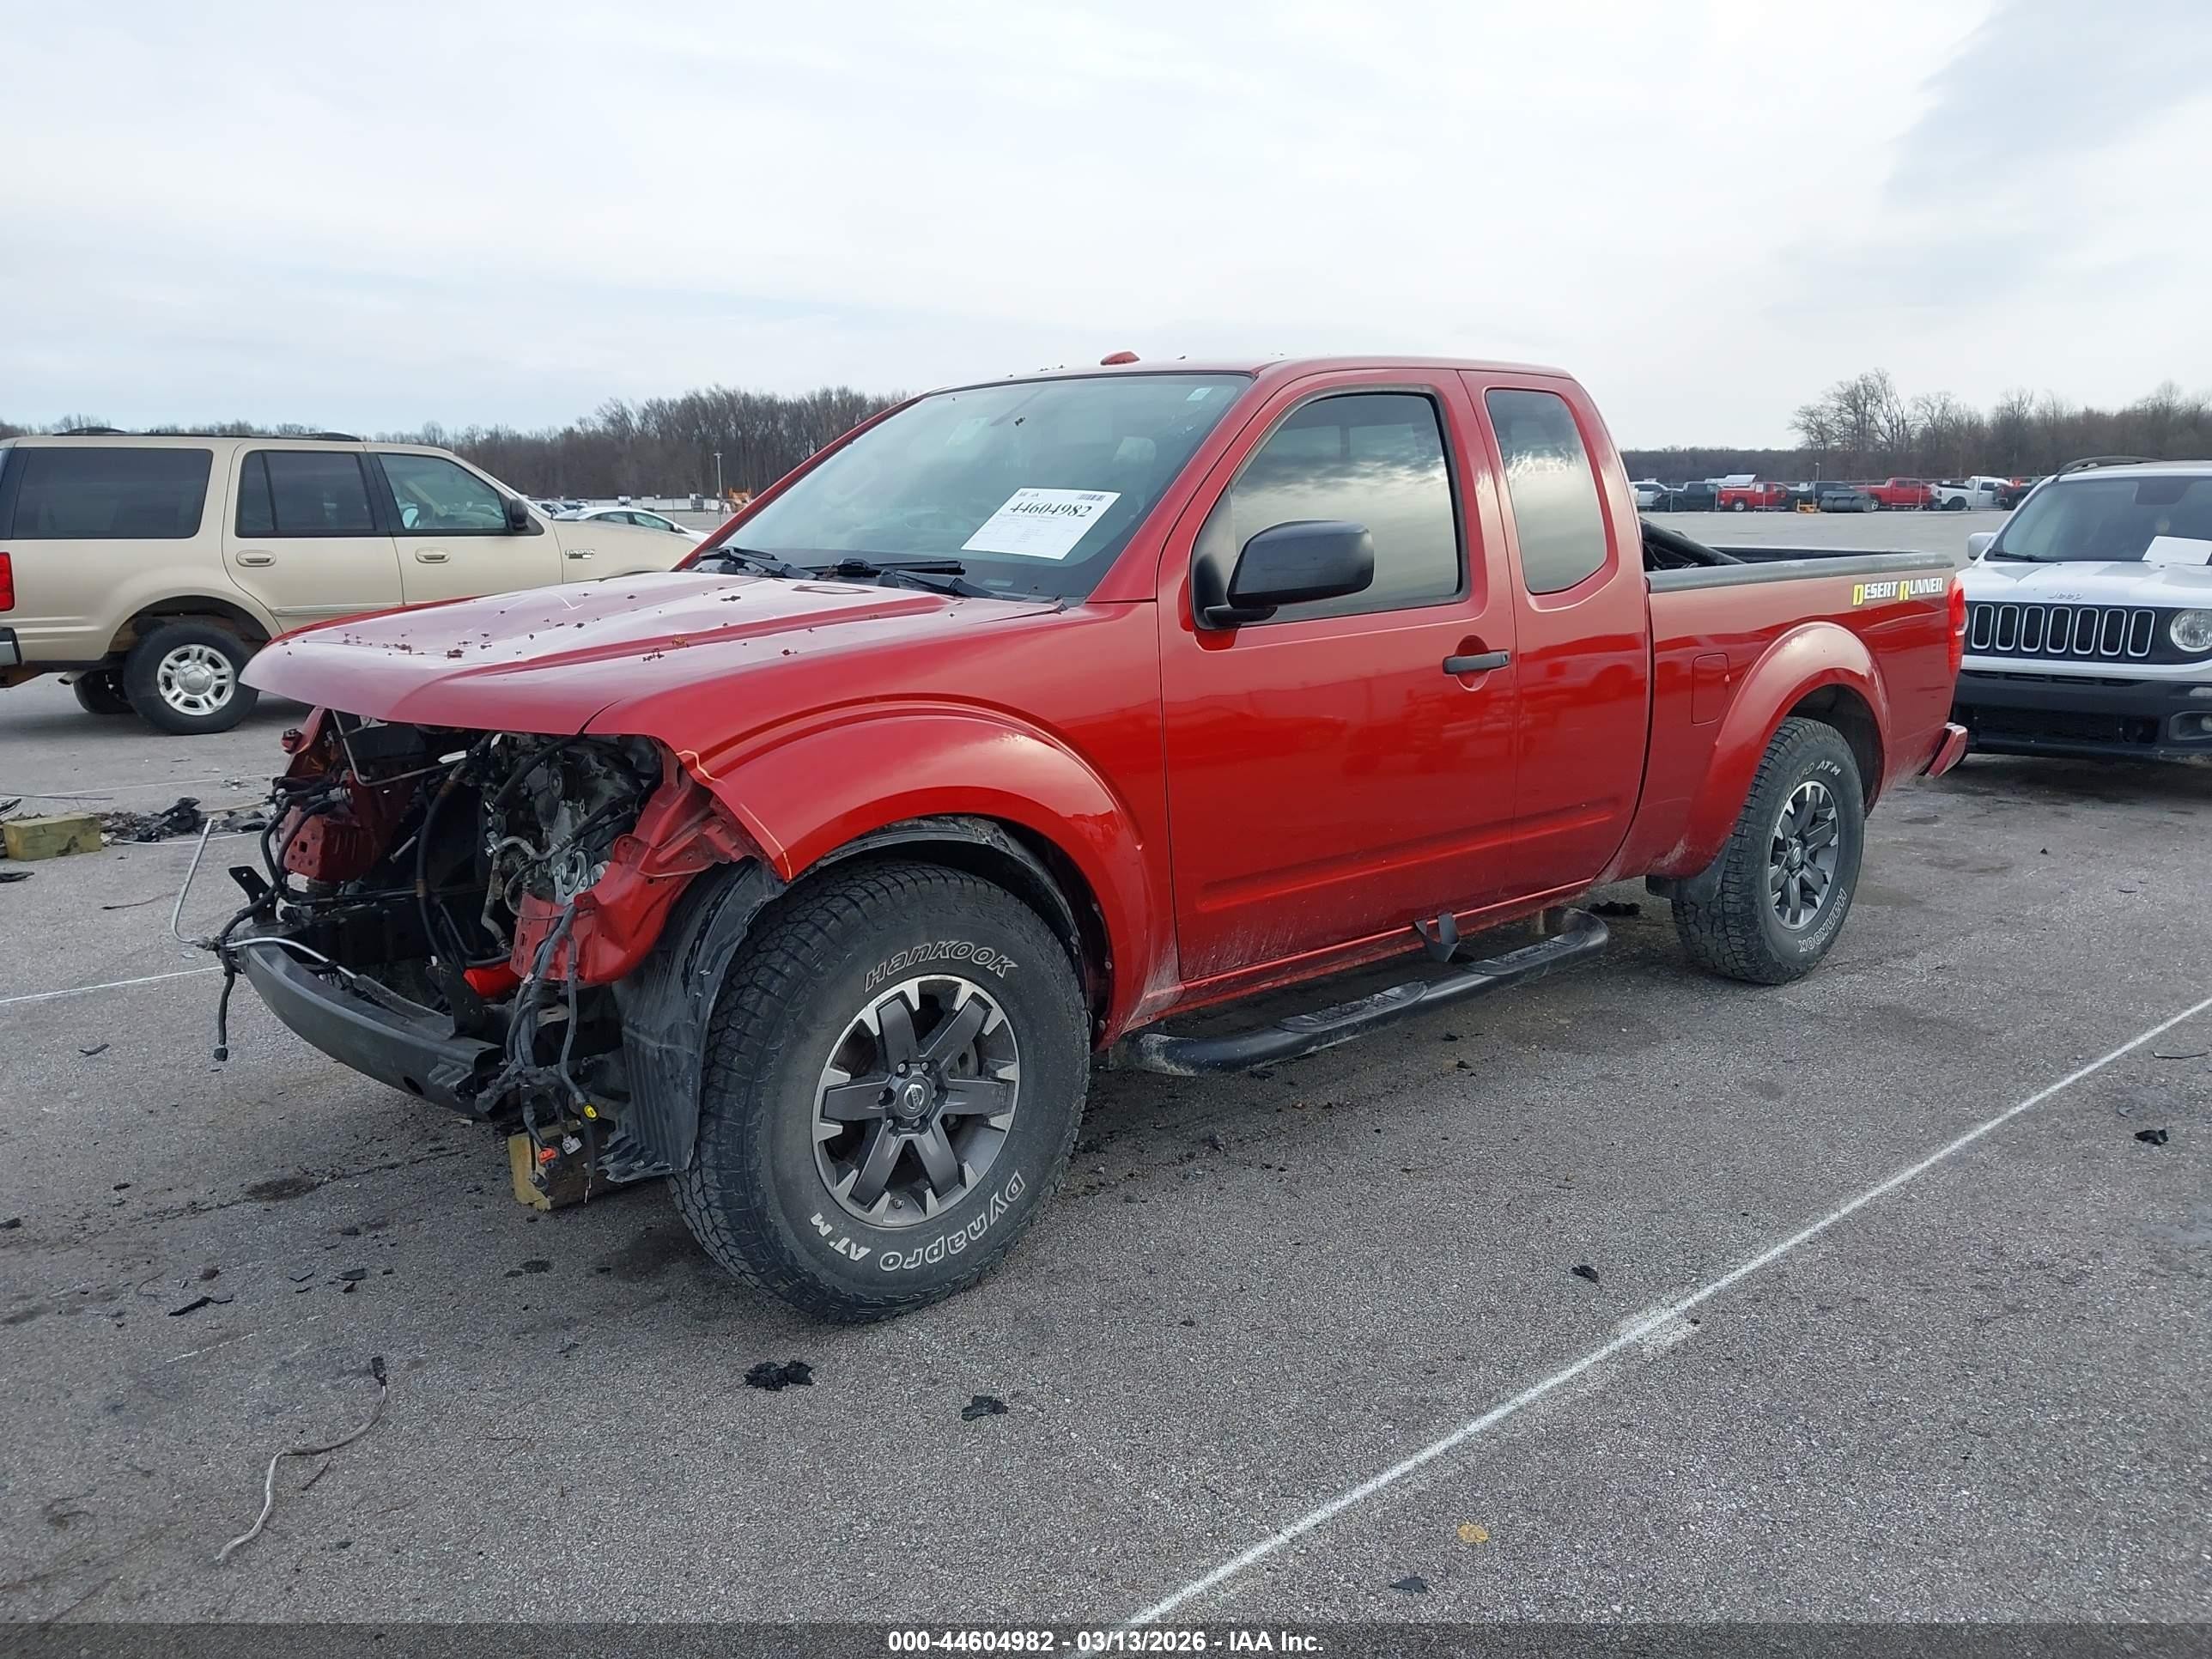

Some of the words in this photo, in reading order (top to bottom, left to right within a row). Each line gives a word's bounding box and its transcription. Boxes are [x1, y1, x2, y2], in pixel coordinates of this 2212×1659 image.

[1010, 501, 1093, 518] 44604982
[1852, 580, 1898, 606] DESERT
[1899, 577, 1943, 601] RUNNER
[2047, 590, 2083, 602] Jeep
